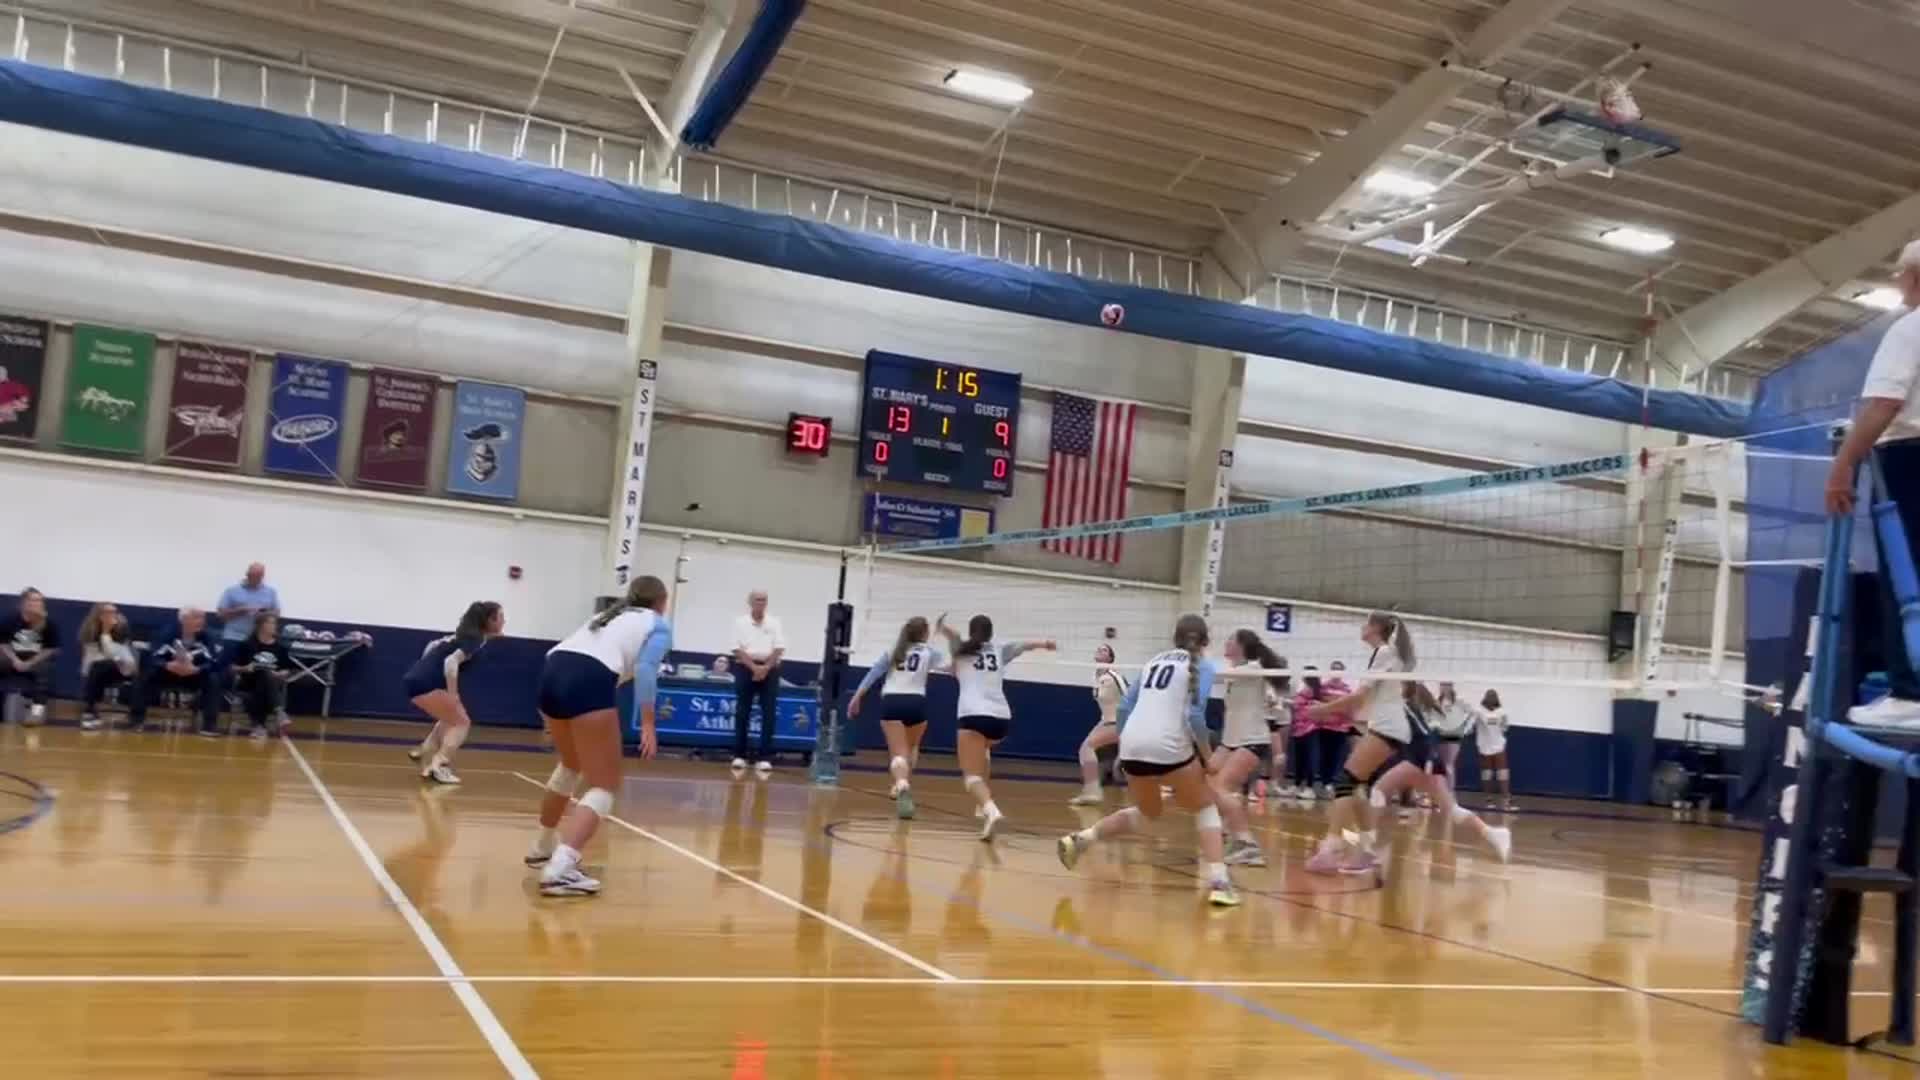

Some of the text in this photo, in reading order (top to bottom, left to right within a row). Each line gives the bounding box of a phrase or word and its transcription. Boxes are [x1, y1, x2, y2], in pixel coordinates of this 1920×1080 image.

[936, 368, 979, 397] 1:15
[888, 407, 911, 432] 13
[974, 403, 1009, 418] GUEST
[792, 420, 824, 449] 30
[942, 416, 949, 435] 1
[995, 421, 1009, 445] 9
[875, 442, 888, 462] 0
[994, 459, 1007, 478] 0
[1551, 454, 1623, 478] LANCERS
[1272, 613, 1286, 630] 2
[1143, 664, 1175, 690] 10
[690, 697, 714, 713] St.
